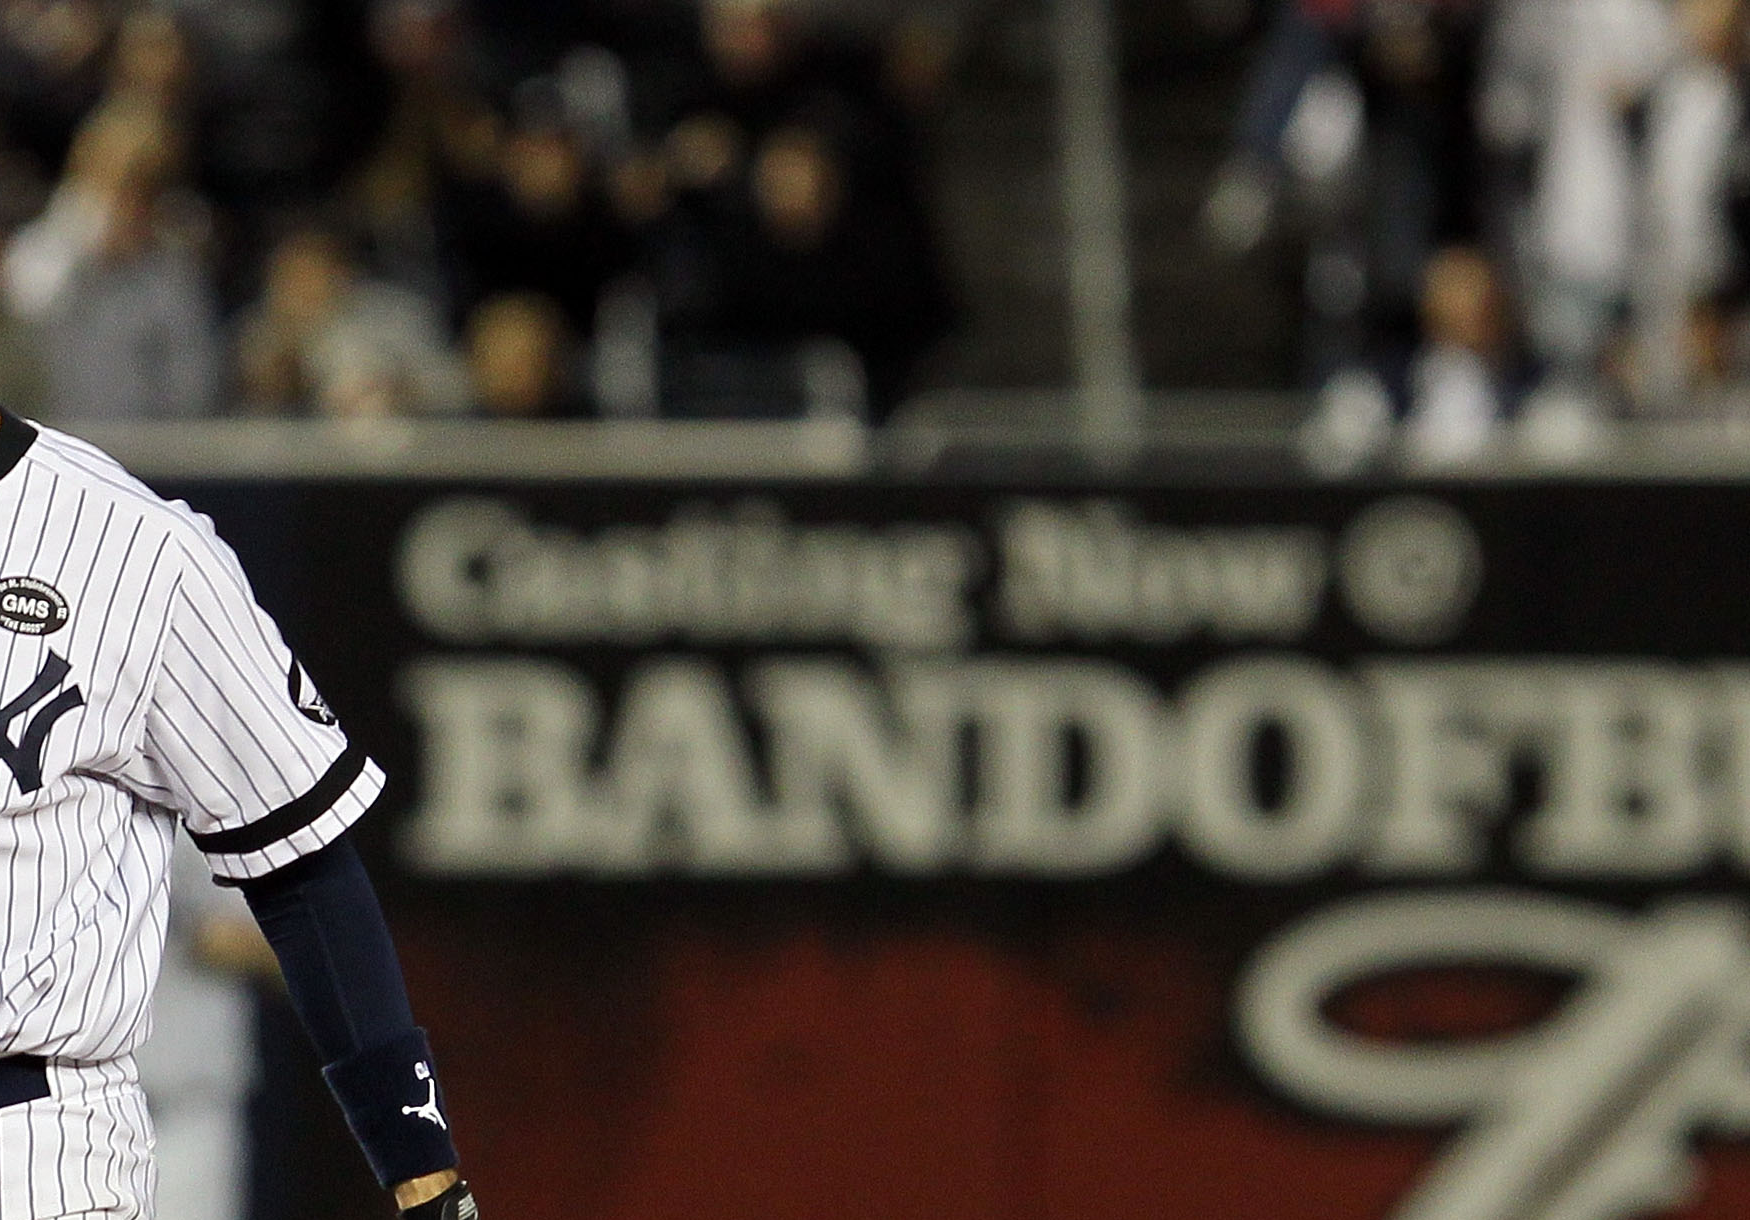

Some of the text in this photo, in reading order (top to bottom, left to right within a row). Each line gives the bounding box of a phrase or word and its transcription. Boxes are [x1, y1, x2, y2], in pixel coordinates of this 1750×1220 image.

[1, 593, 50, 620] GMS
[398, 499, 970, 652] Casting
[1000, 502, 1326, 637] Now
